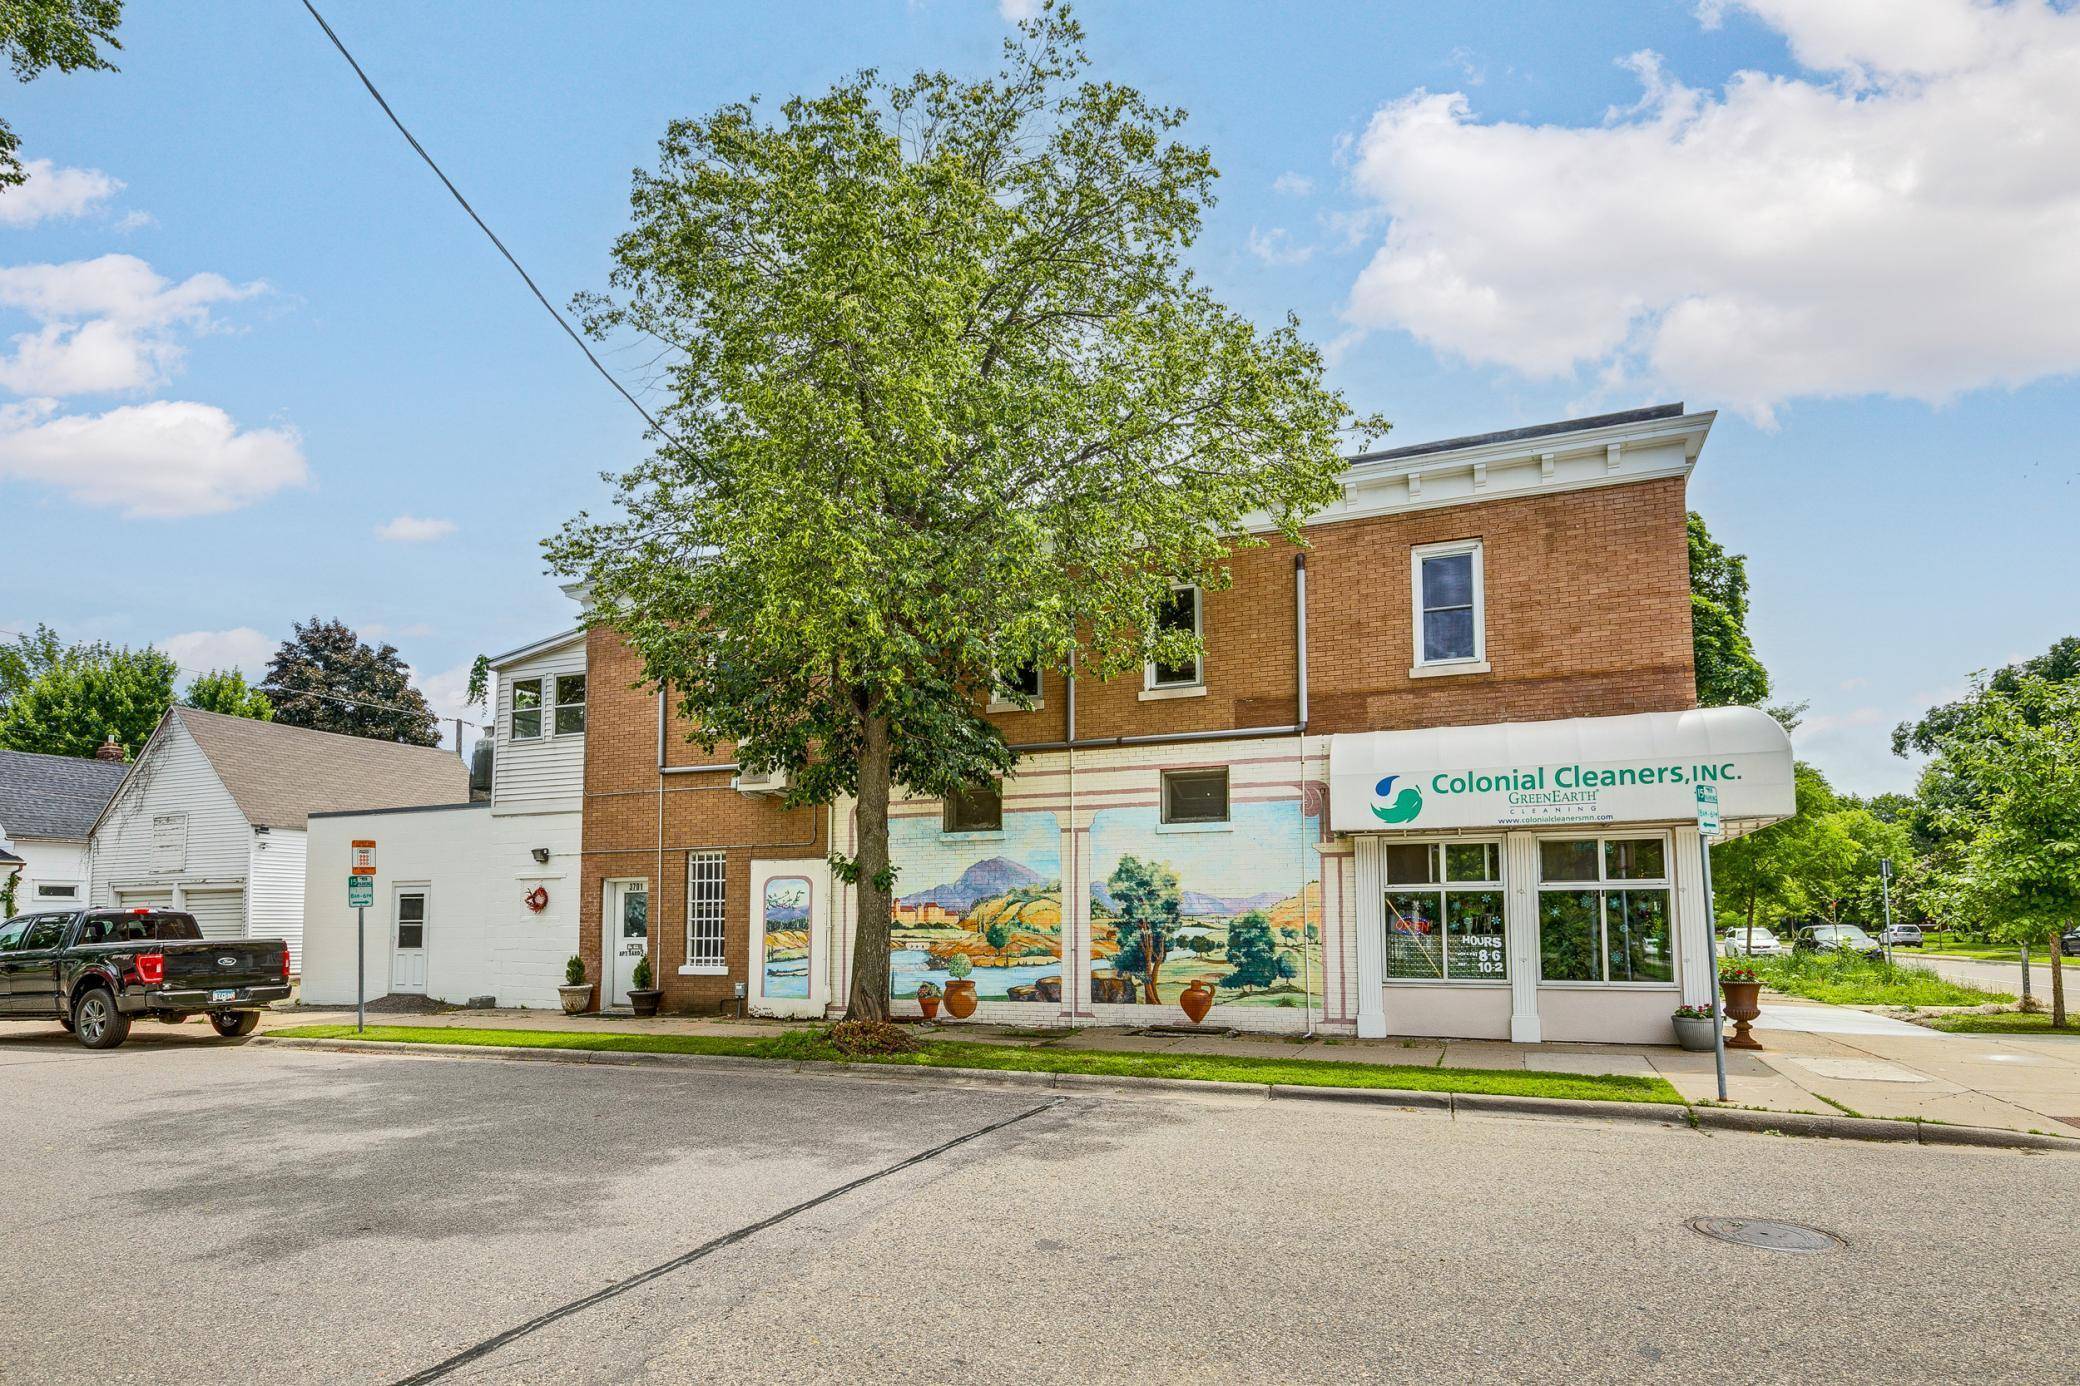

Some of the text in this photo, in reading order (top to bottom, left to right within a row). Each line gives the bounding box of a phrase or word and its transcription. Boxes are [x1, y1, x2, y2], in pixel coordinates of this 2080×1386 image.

[1432, 766, 1544, 794] Colonial
[1509, 806, 1597, 815] CLEANING
[1498, 814, 1614, 824] www.colonialcleanersmn.com
[1395, 918, 1430, 933] OPEN
[1462, 935, 1502, 948] HOURS
[1478, 961, 1504, 973] 10-2
